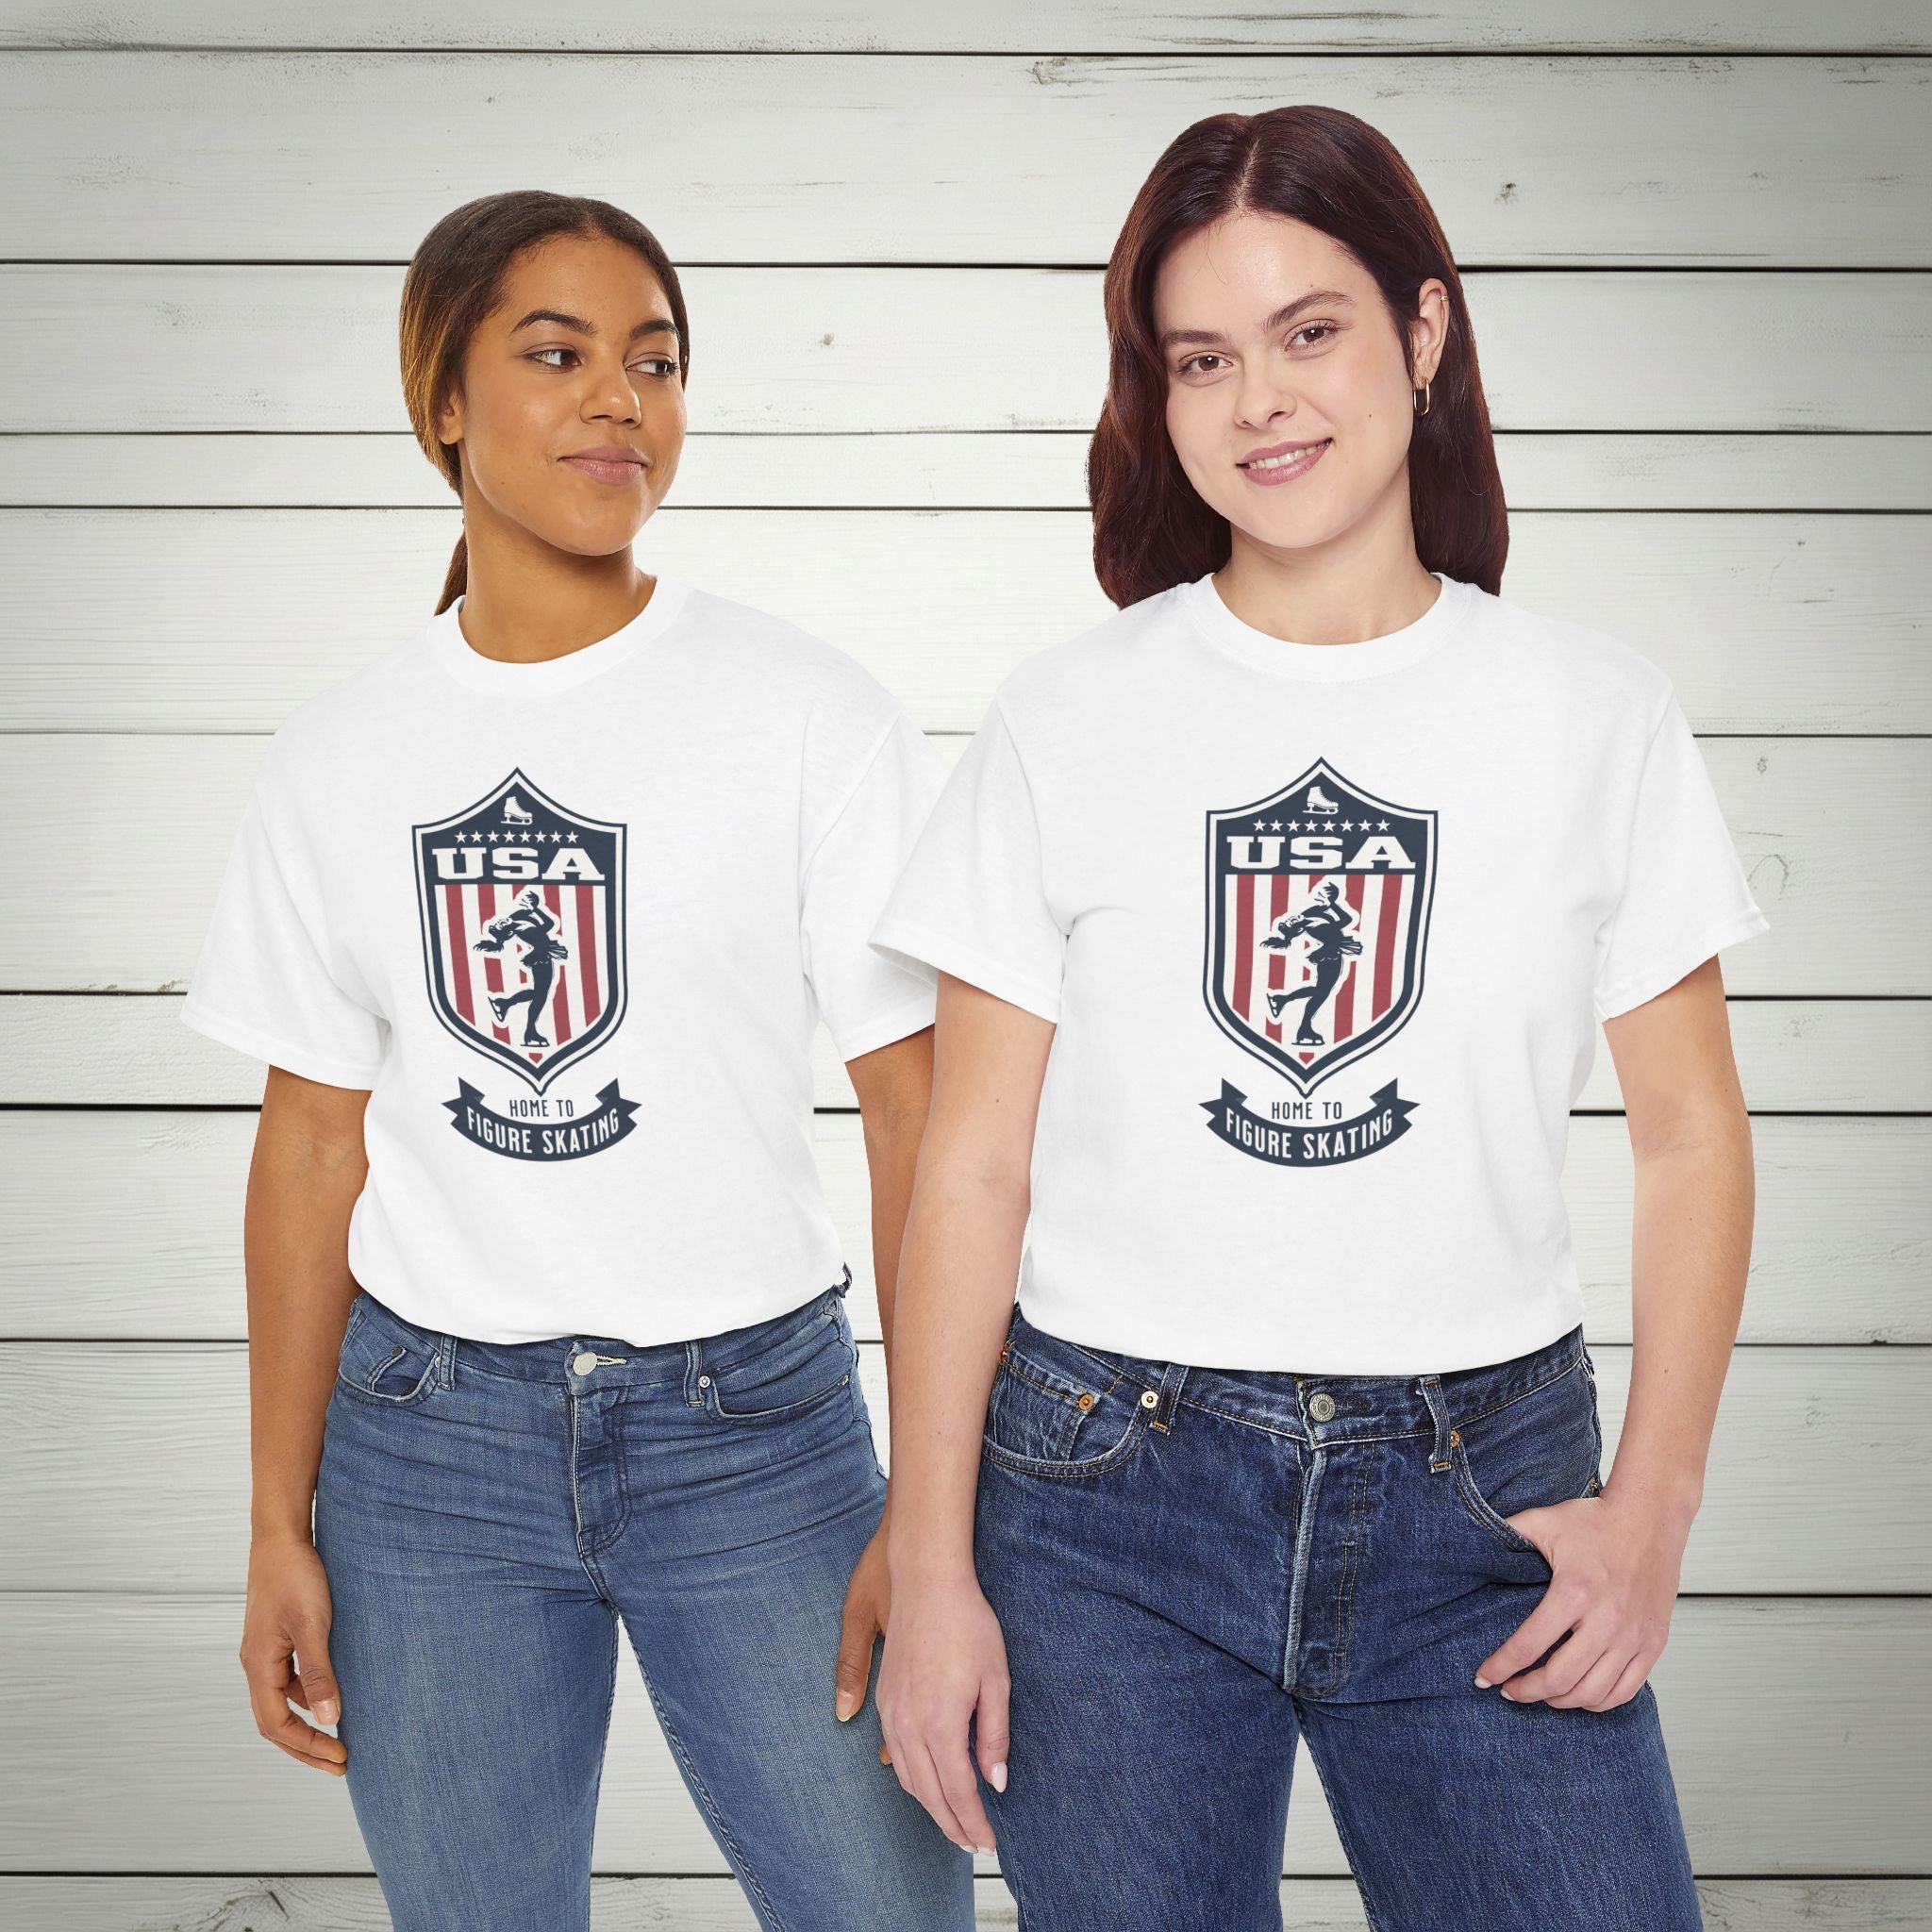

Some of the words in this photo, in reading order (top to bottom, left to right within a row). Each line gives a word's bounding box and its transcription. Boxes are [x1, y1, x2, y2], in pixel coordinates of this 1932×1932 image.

[432, 847, 605, 880] USA
[1226, 836, 1416, 870] USA
[508, 1099, 549, 1117] HOME
[556, 1099, 574, 1117] TO
[1272, 1102, 1313, 1120] HOME
[1322, 1102, 1342, 1120] TO
[466, 1106, 532, 1154] FIGURE
[542, 1108, 619, 1154] SKATING
[1226, 1107, 1291, 1158] FIGURE
[1303, 1108, 1392, 1158] SKATING
